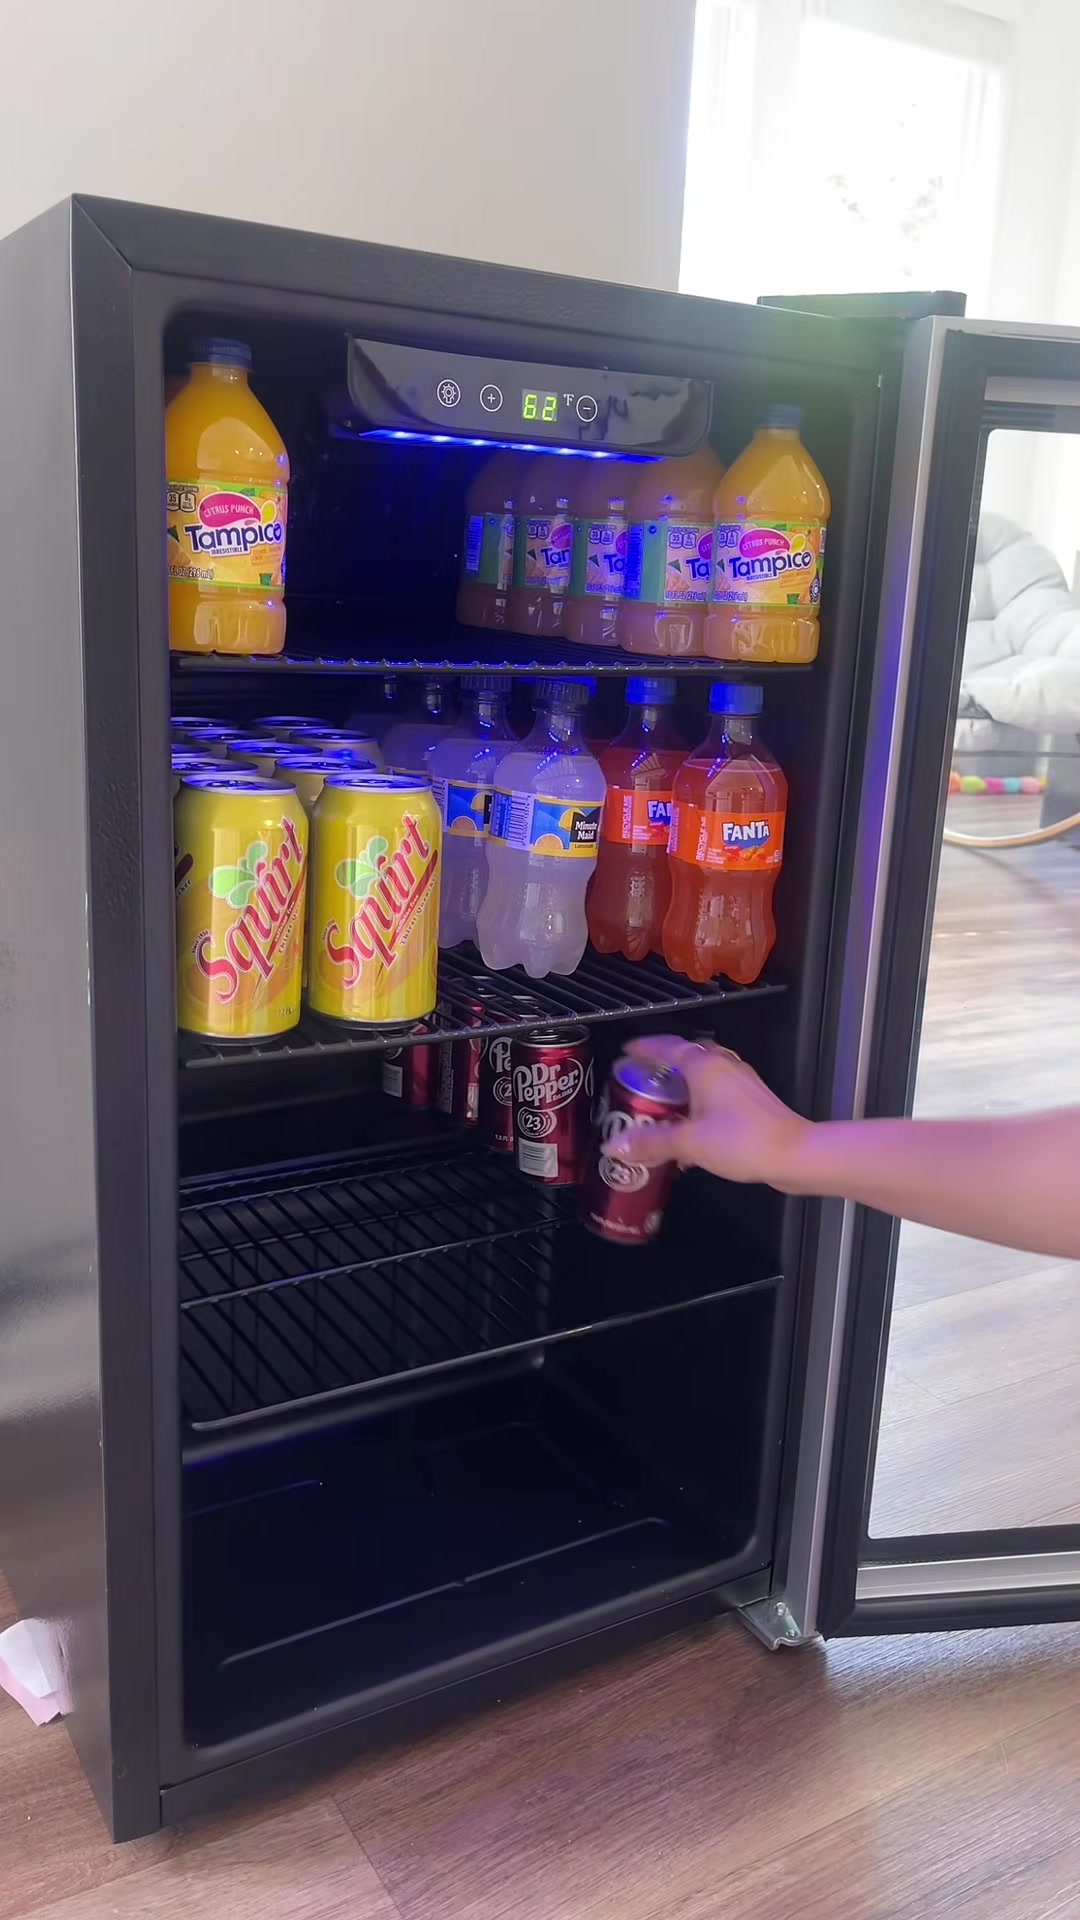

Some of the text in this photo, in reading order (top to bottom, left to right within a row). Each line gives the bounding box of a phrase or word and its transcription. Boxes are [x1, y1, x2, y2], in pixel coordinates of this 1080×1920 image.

[523, 393, 557, 421] 62
[168, 493, 177, 502] 35
[203, 503, 230, 518] CITRUS
[230, 503, 254, 515] PUNCH
[184, 523, 282, 551] Tampico
[742, 538, 763, 551] CITRUS
[764, 537, 785, 546] PUNCH
[211, 547, 243, 555] IRRESISTIBLE
[728, 551, 811, 578] Tampico
[574, 821, 598, 830] Minute
[577, 830, 594, 840] Maid
[722, 820, 770, 841] FANTA
[326, 811, 430, 988] Squirt
[197, 817, 304, 1004] Squirt
[401, 917, 417, 945] Thirst
[531, 1062, 561, 1086] Dr
[526, 1114, 541, 1131] 23
